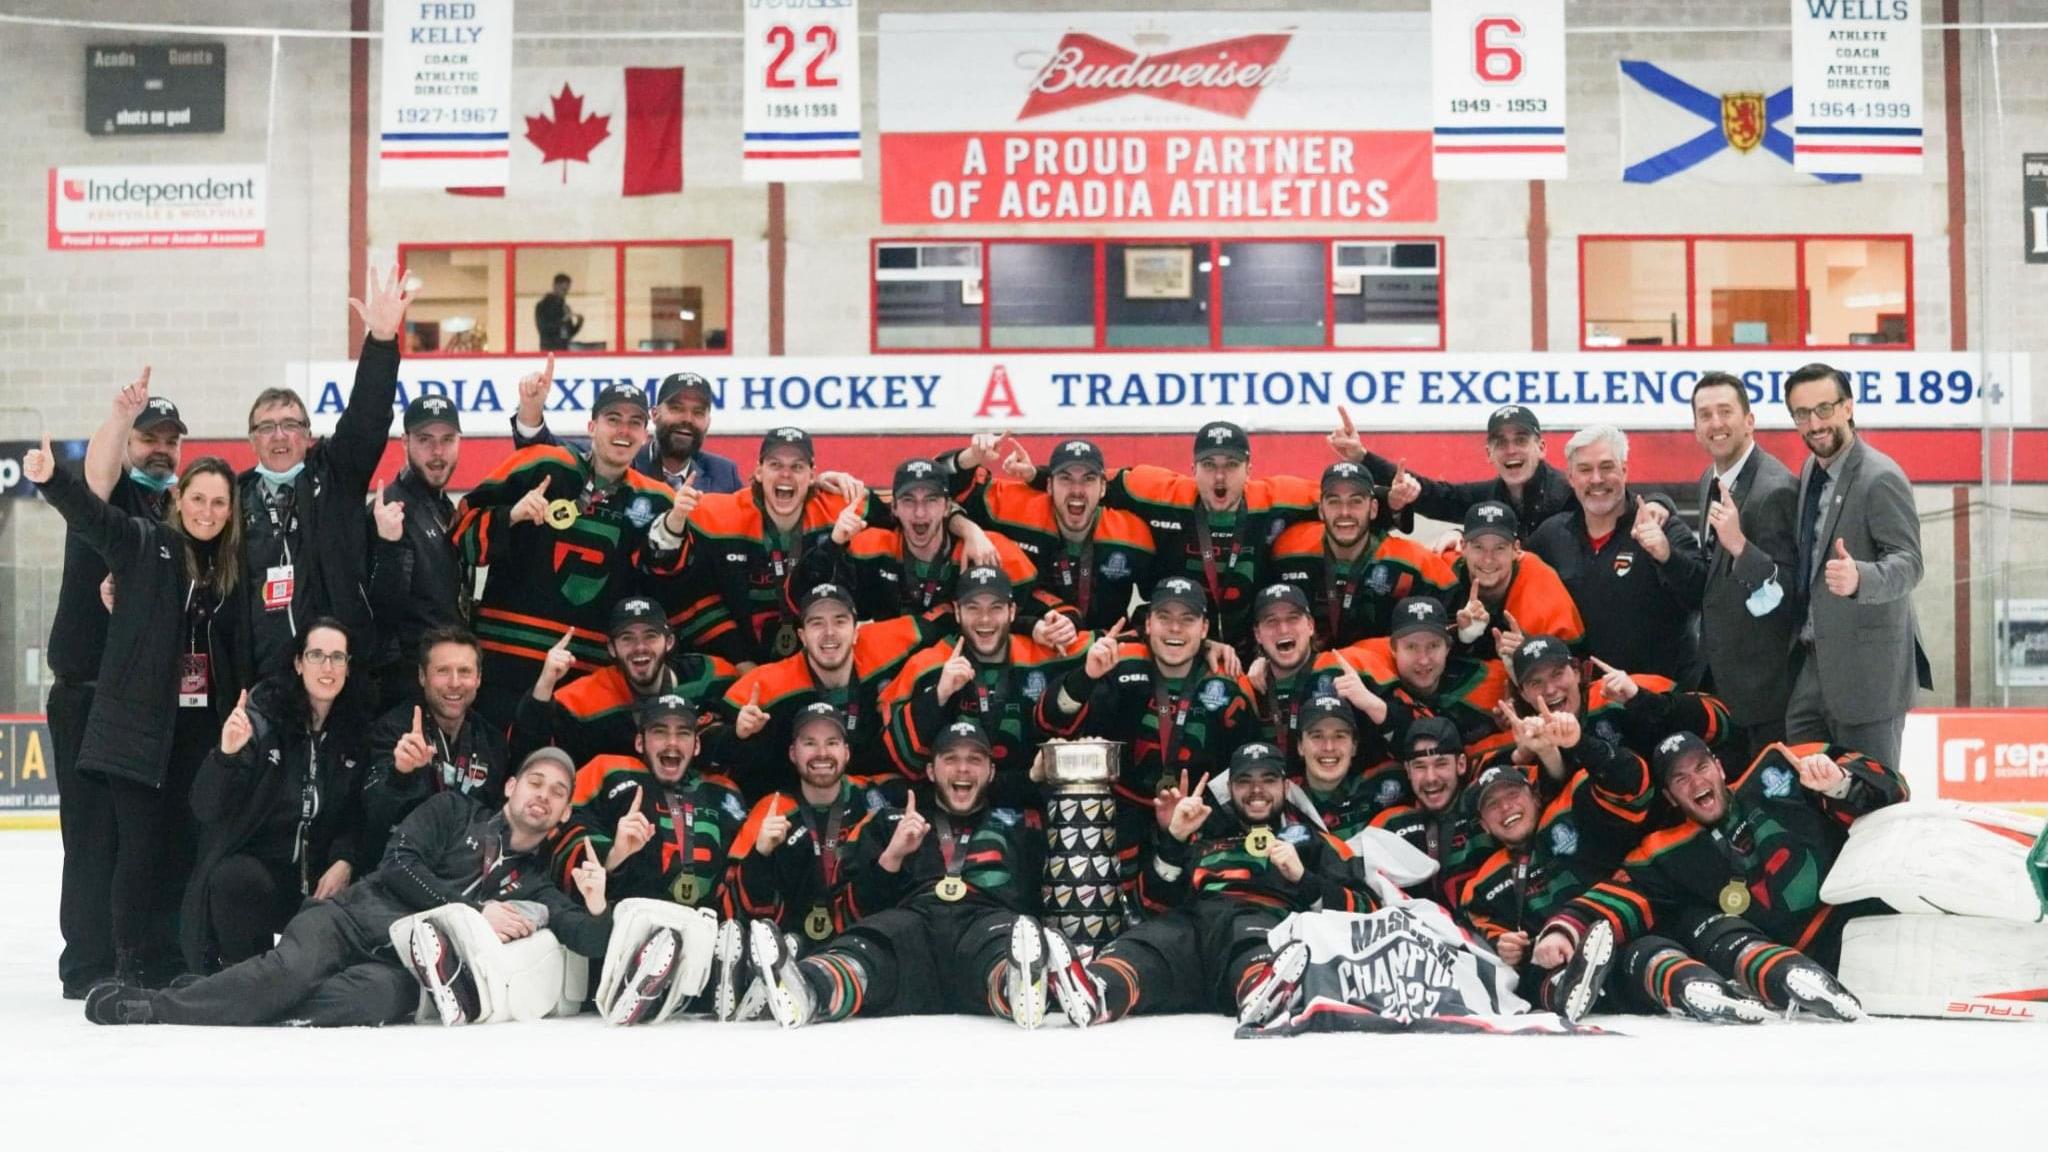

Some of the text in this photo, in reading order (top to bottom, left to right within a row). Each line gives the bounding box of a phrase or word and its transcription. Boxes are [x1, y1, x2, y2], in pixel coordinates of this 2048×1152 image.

[421, 3, 475, 20] FRED
[1807, 0, 1909, 20] WELLS
[411, 27, 481, 43] KELLY
[1829, 31, 1887, 41] ATHLETE
[765, 24, 839, 88] 22
[1475, 18, 1522, 81] 6
[1836, 49, 1880, 58] COACH
[425, 55, 468, 64] COACH
[415, 72, 479, 81] ATHLETIC
[1015, 46, 1290, 93] Budweiser
[1828, 66, 1891, 76] ATHLETIC
[415, 86, 478, 95] DIRECTOR
[1828, 80, 1890, 89] DIRECTOR
[1450, 99, 1491, 112] 1949
[1507, 99, 1547, 112] 1953
[1810, 102, 1911, 118] 1964-1999
[398, 108, 498, 123] 1927-1967
[963, 137, 1355, 174] A PROUD PARTNER
[88, 178, 255, 208] Independent
[930, 179, 1389, 218] OF ACADIA ATHLETICS
[741, 375, 941, 409] HOCKEY
[975, 364, 1024, 417] A
[1052, 371, 1333, 406] TRADITION
[1345, 370, 1405, 405] OF
